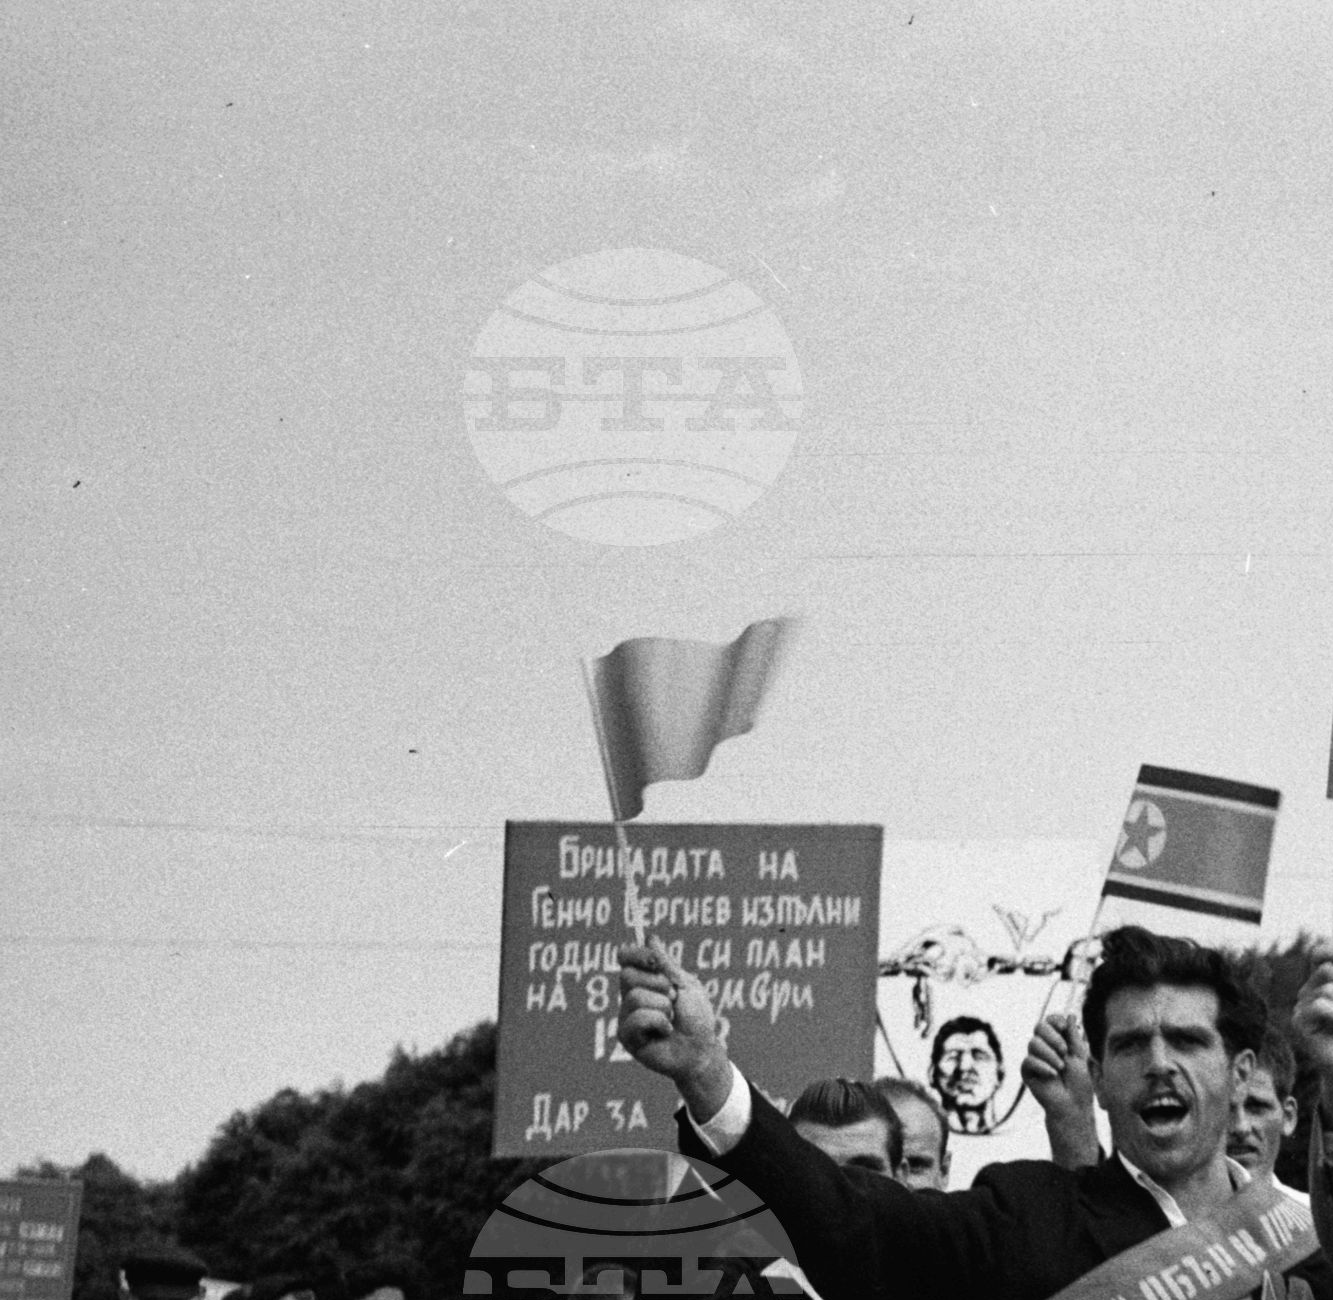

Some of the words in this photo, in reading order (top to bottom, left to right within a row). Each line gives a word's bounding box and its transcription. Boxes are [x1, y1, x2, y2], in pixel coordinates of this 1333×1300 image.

[558, 834, 725, 888] БРИГАДАТА
[758, 849, 800, 882] НА
[531, 885, 611, 928] ГЕНЧО
[624, 895, 732, 928] СЕРГИЕВ
[742, 895, 862, 928] ИЗПЪЛНИ
[697, 937, 732, 970] СИ
[746, 937, 826, 970] ПЛАН
[526, 982, 568, 1013] НА
[586, 973, 610, 1012] 8
[525, 1091, 590, 1142] ДАР
[605, 1099, 648, 1133] ЗА
